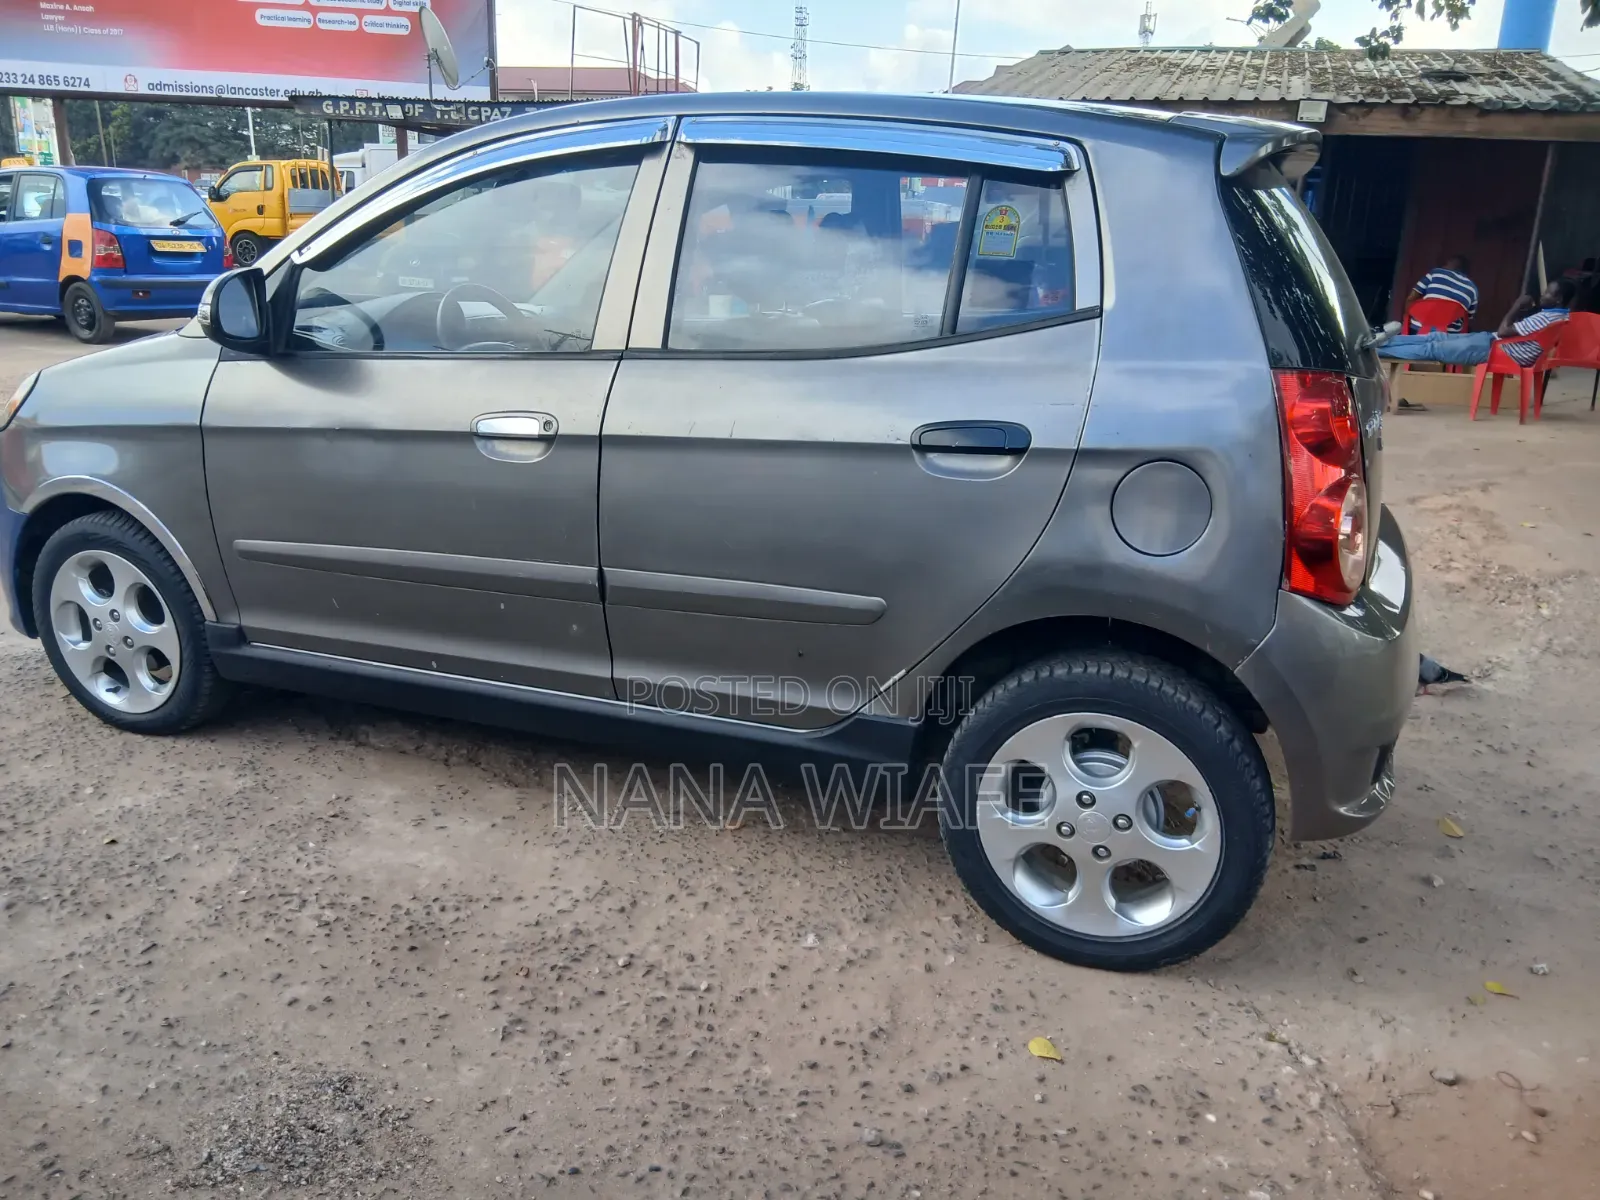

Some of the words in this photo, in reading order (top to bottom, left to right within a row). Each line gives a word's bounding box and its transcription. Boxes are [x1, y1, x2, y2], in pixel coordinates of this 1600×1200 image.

[40, 2, 64, 10] Maxine
[41, 13, 65, 22] Lawyer
[287, 16, 312, 24] learning
[317, 17, 357, 25] Research-led
[55, 24, 78, 34] (Hons)
[109, 28, 124, 36] 2017
[385, 22, 409, 31] thinking
[0, 71, 18, 84] 233
[20, 73, 36, 85] 24
[38, 74, 61, 87] 865
[62, 76, 91, 89] 6274
[147, 80, 323, 98] admissions@lancaster.eduh
[405, 103, 424, 117] OF
